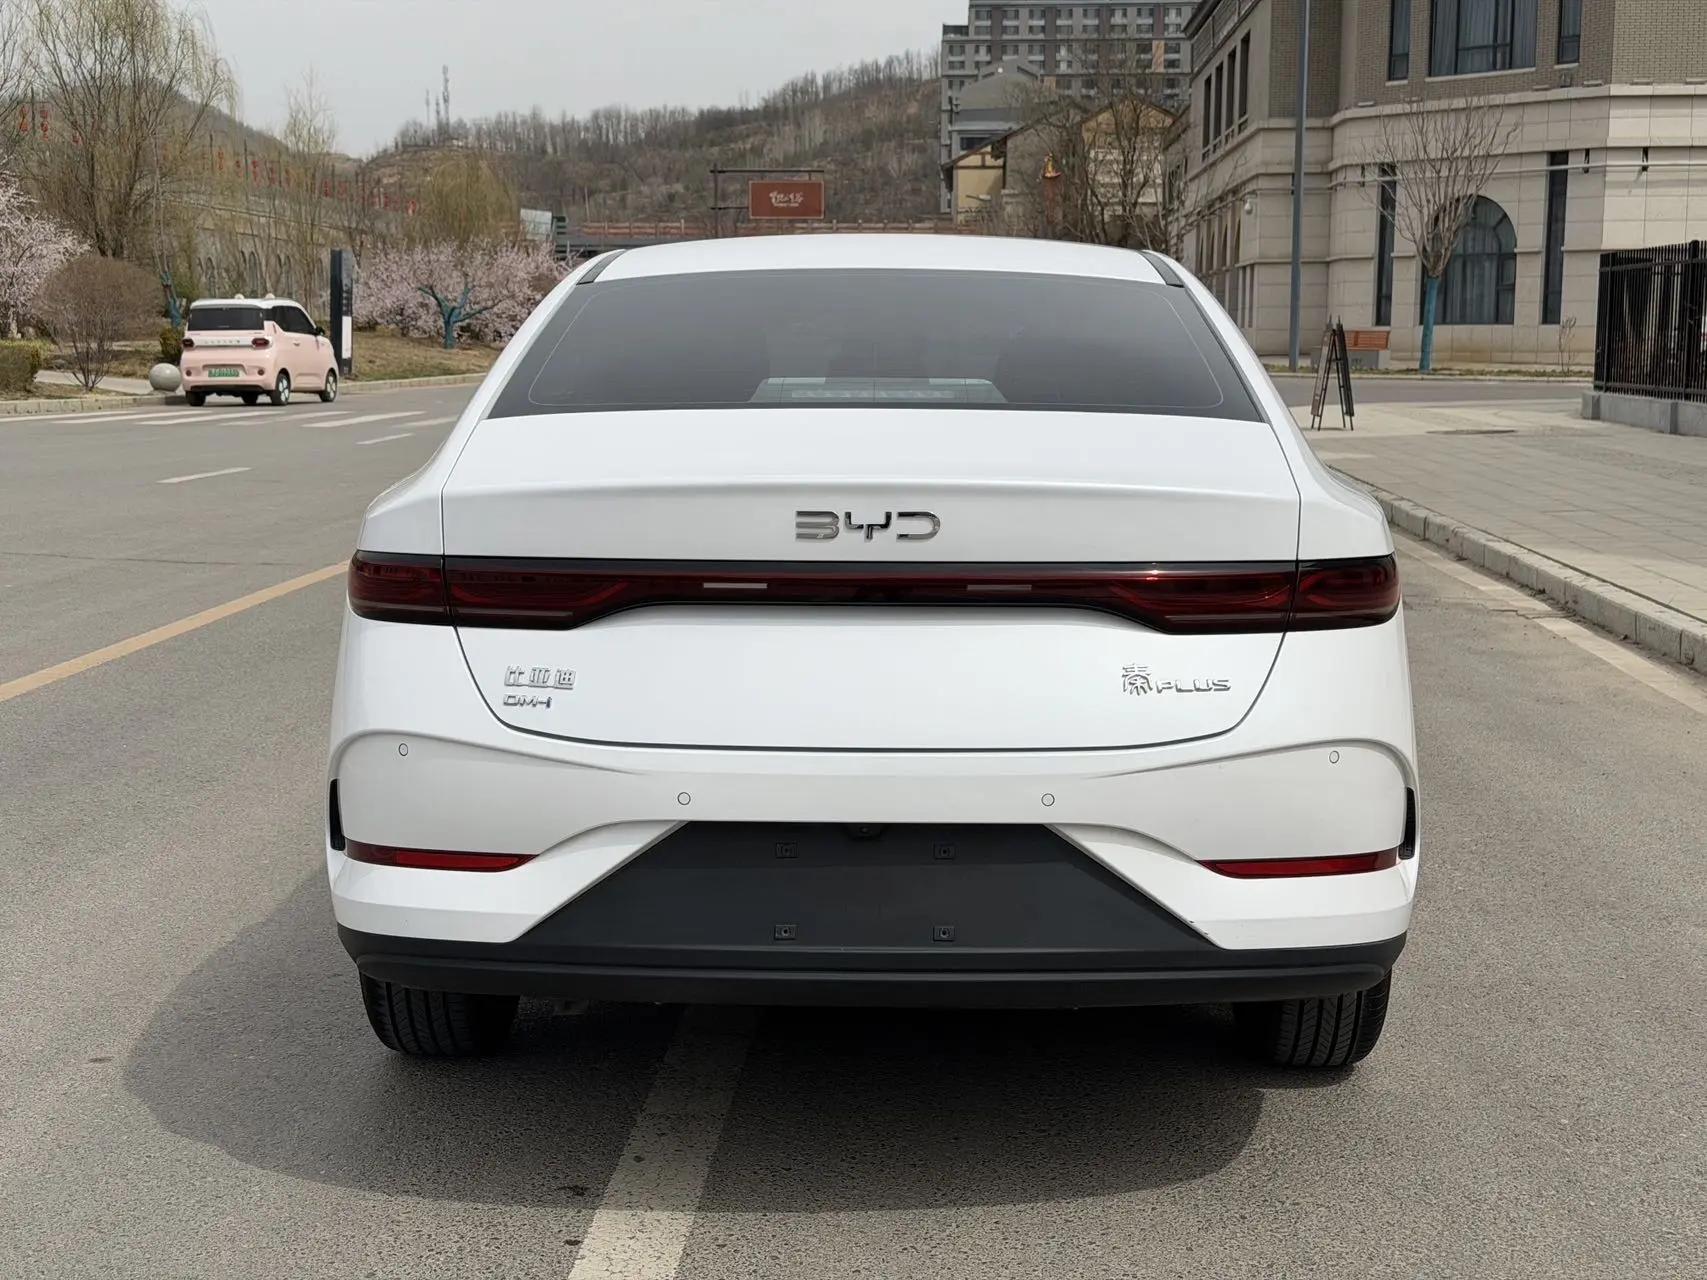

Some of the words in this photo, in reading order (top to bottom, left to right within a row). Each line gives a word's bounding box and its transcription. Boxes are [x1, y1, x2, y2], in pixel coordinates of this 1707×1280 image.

[796, 510, 941, 540] BYD
[504, 665, 576, 690] 比亚迪
